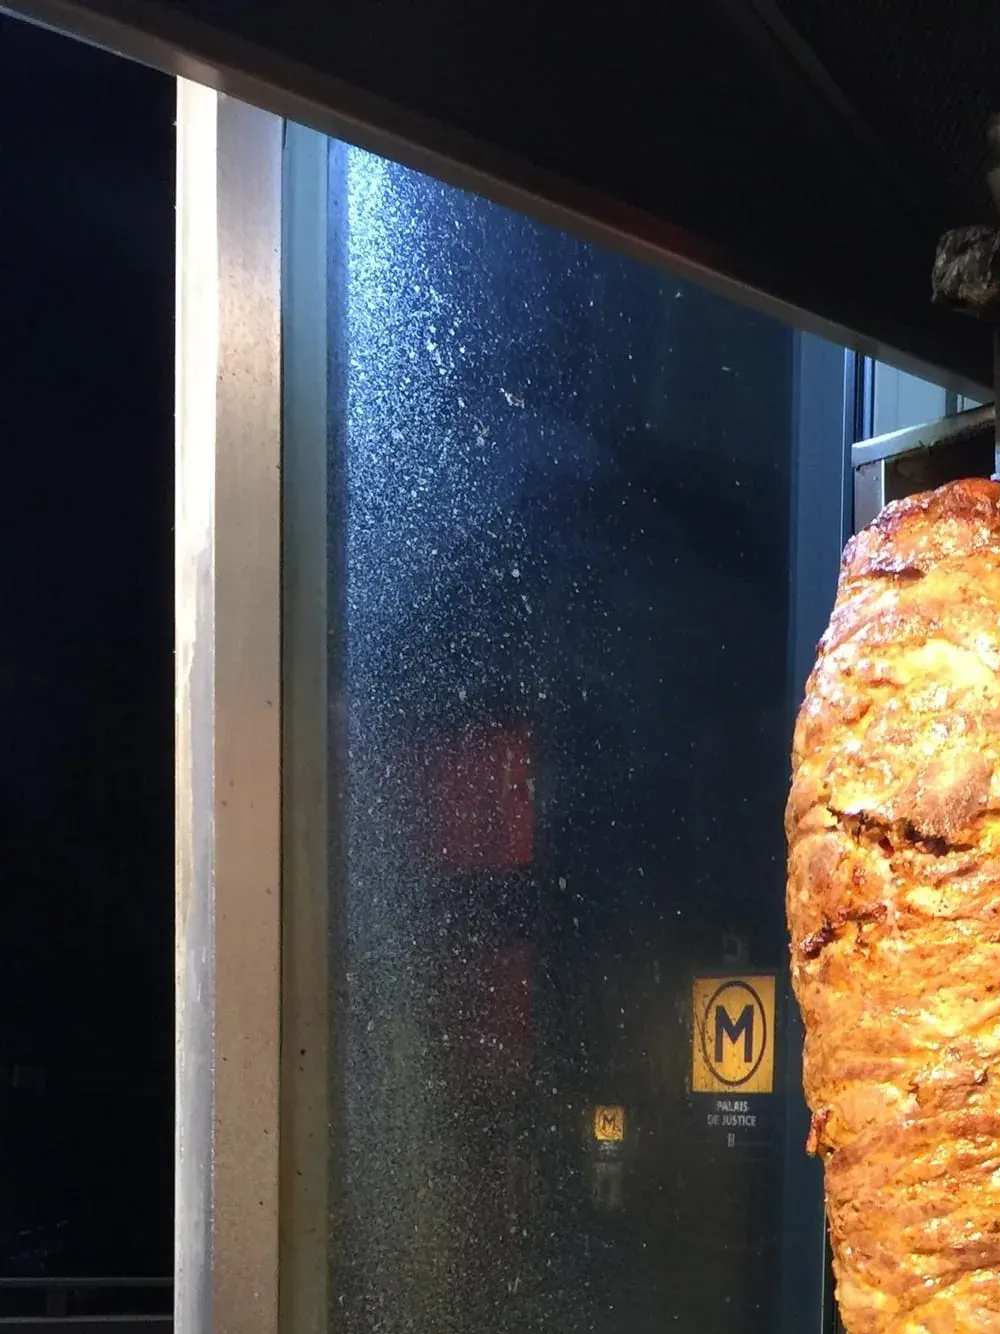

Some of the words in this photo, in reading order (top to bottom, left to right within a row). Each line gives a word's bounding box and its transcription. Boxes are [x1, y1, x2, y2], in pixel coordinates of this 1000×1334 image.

[715, 1004, 754, 1063] M
[717, 1101, 748, 1112] PALAIS
[707, 1114, 720, 1125] DE
[722, 1114, 757, 1127] JUSTICE
